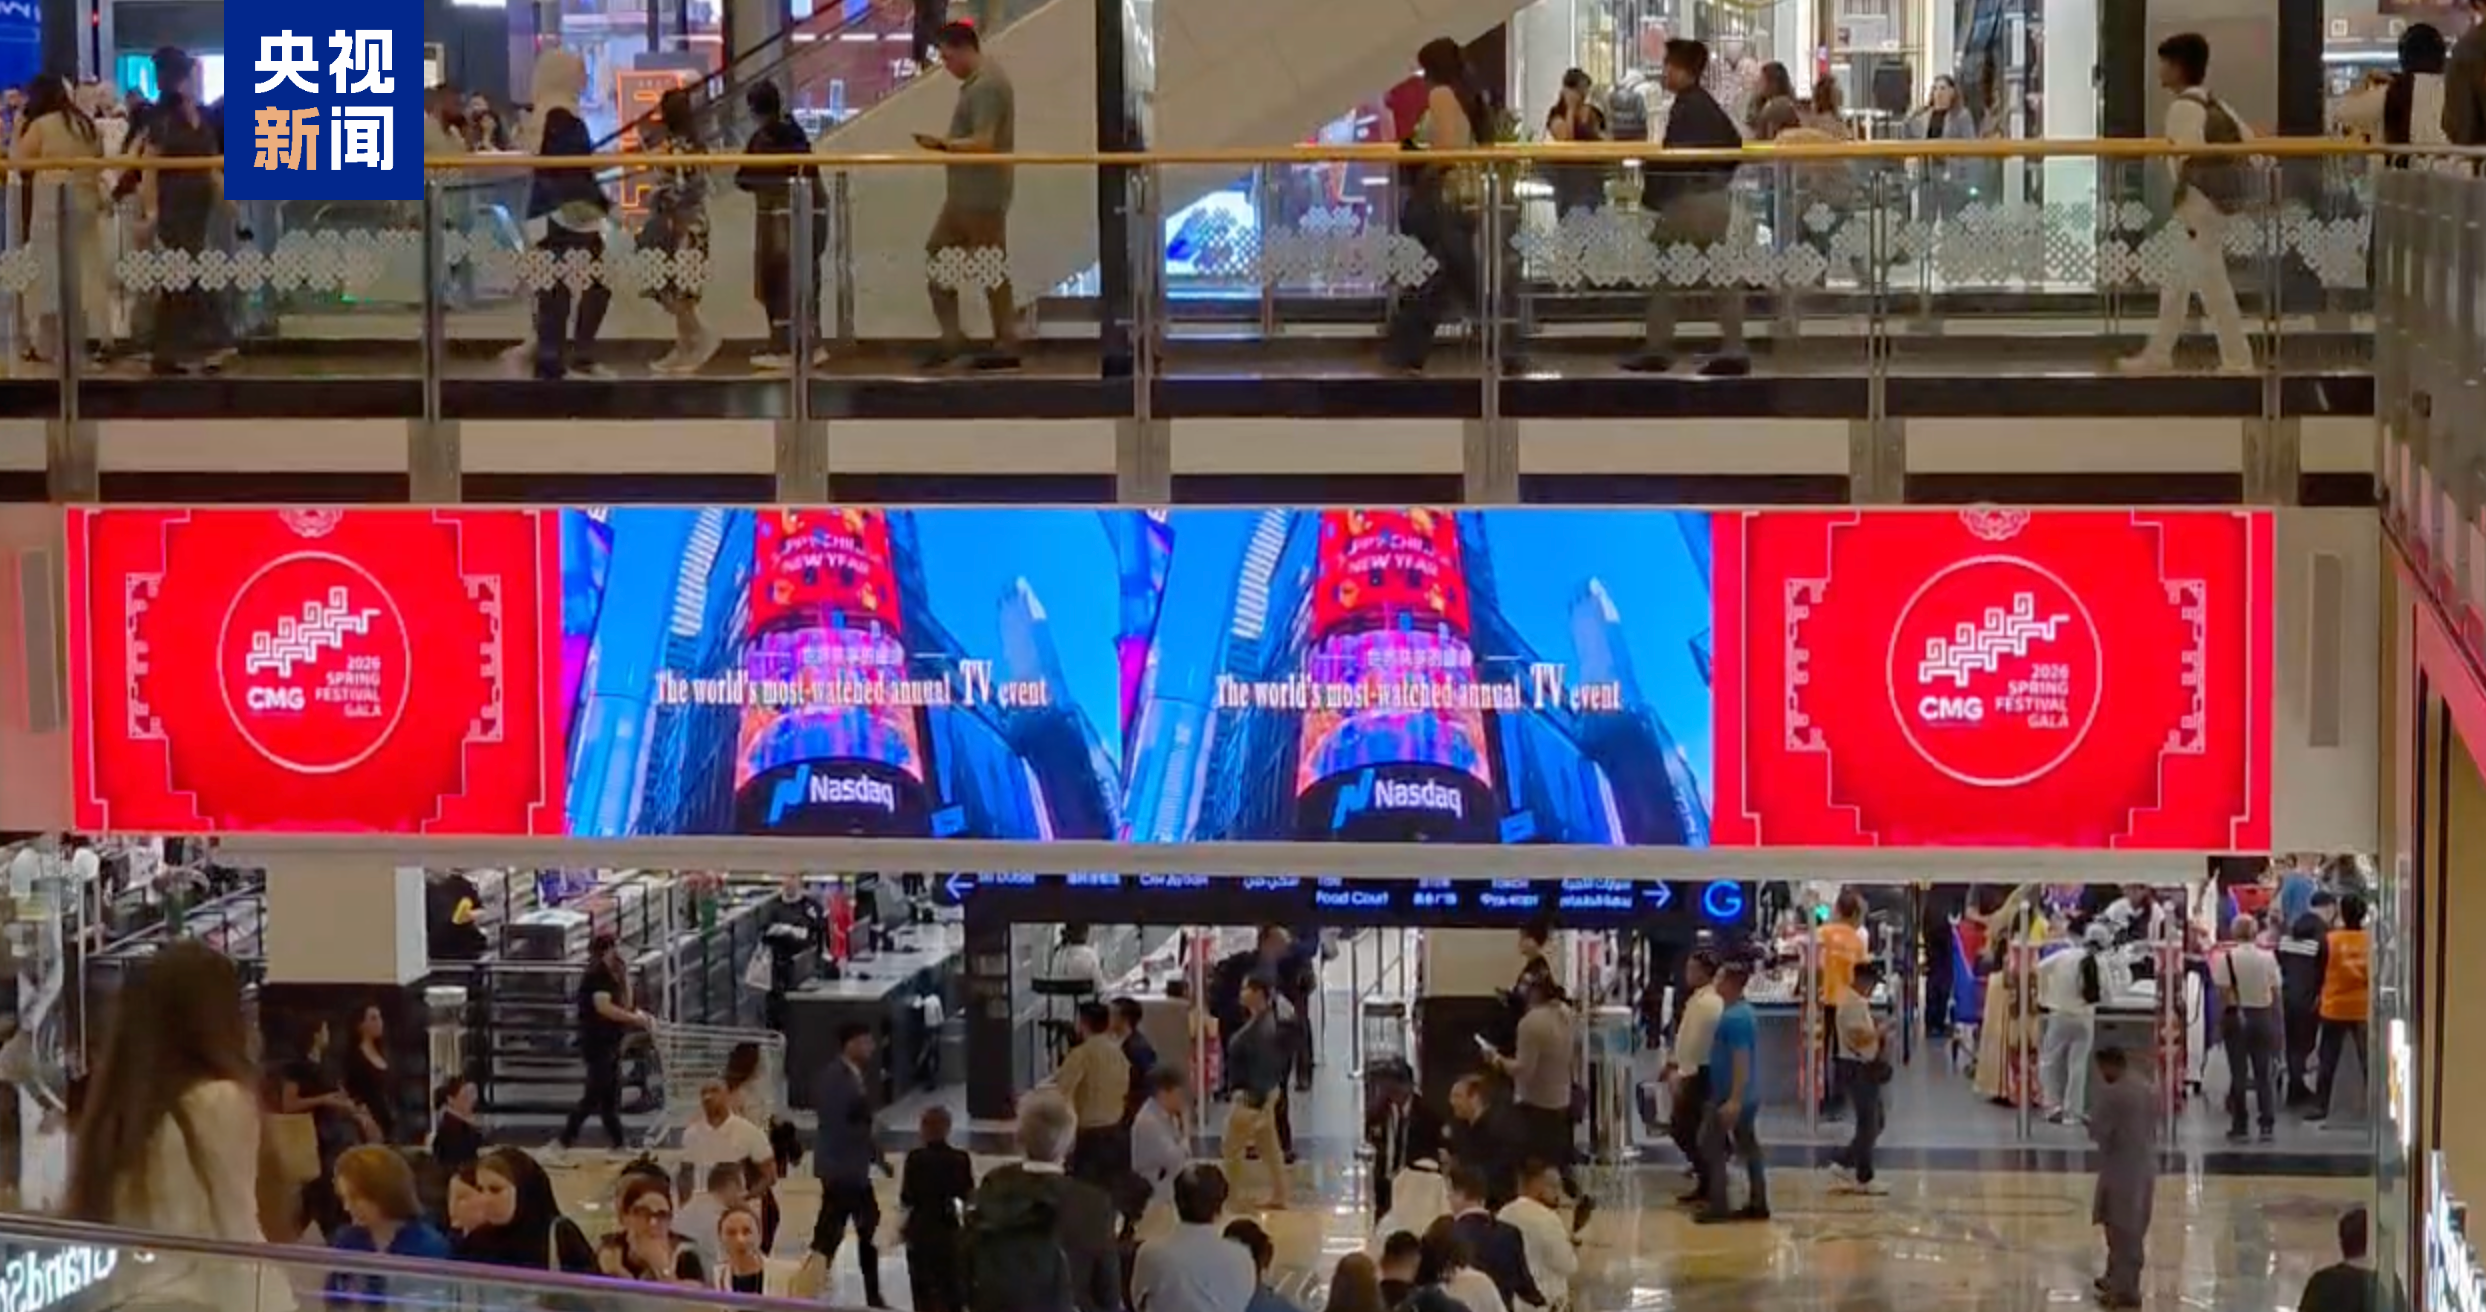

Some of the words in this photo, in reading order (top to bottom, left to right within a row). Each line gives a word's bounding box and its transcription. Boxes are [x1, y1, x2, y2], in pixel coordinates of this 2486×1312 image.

[326, 670, 381, 686] SPRING
[2031, 663, 2070, 680] 2026
[315, 686, 380, 702] FESTIVAL
[656, 668, 689, 704] The
[693, 670, 757, 705] world's
[763, 669, 884, 706] most-watched
[891, 671, 949, 705] annual
[959, 659, 993, 706] TV
[997, 676, 1049, 709] event
[1216, 673, 1250, 708] The
[1253, 673, 1321, 709] world's
[1326, 673, 1452, 709] most-watched
[1457, 673, 1520, 709] annual
[1529, 662, 1566, 710] TV
[1570, 680, 1622, 714] event
[2008, 679, 2069, 696] SPRING
[247, 686, 305, 711] CMG
[1918, 696, 1984, 721] CMG
[1995, 696, 2069, 713] FESTIVAL
[344, 702, 382, 718] GALA
[2028, 713, 2070, 729] GALA
[809, 774, 895, 813] Nasdaq
[1374, 778, 1462, 819] Nasdaq
[1704, 878, 1741, 916] G
